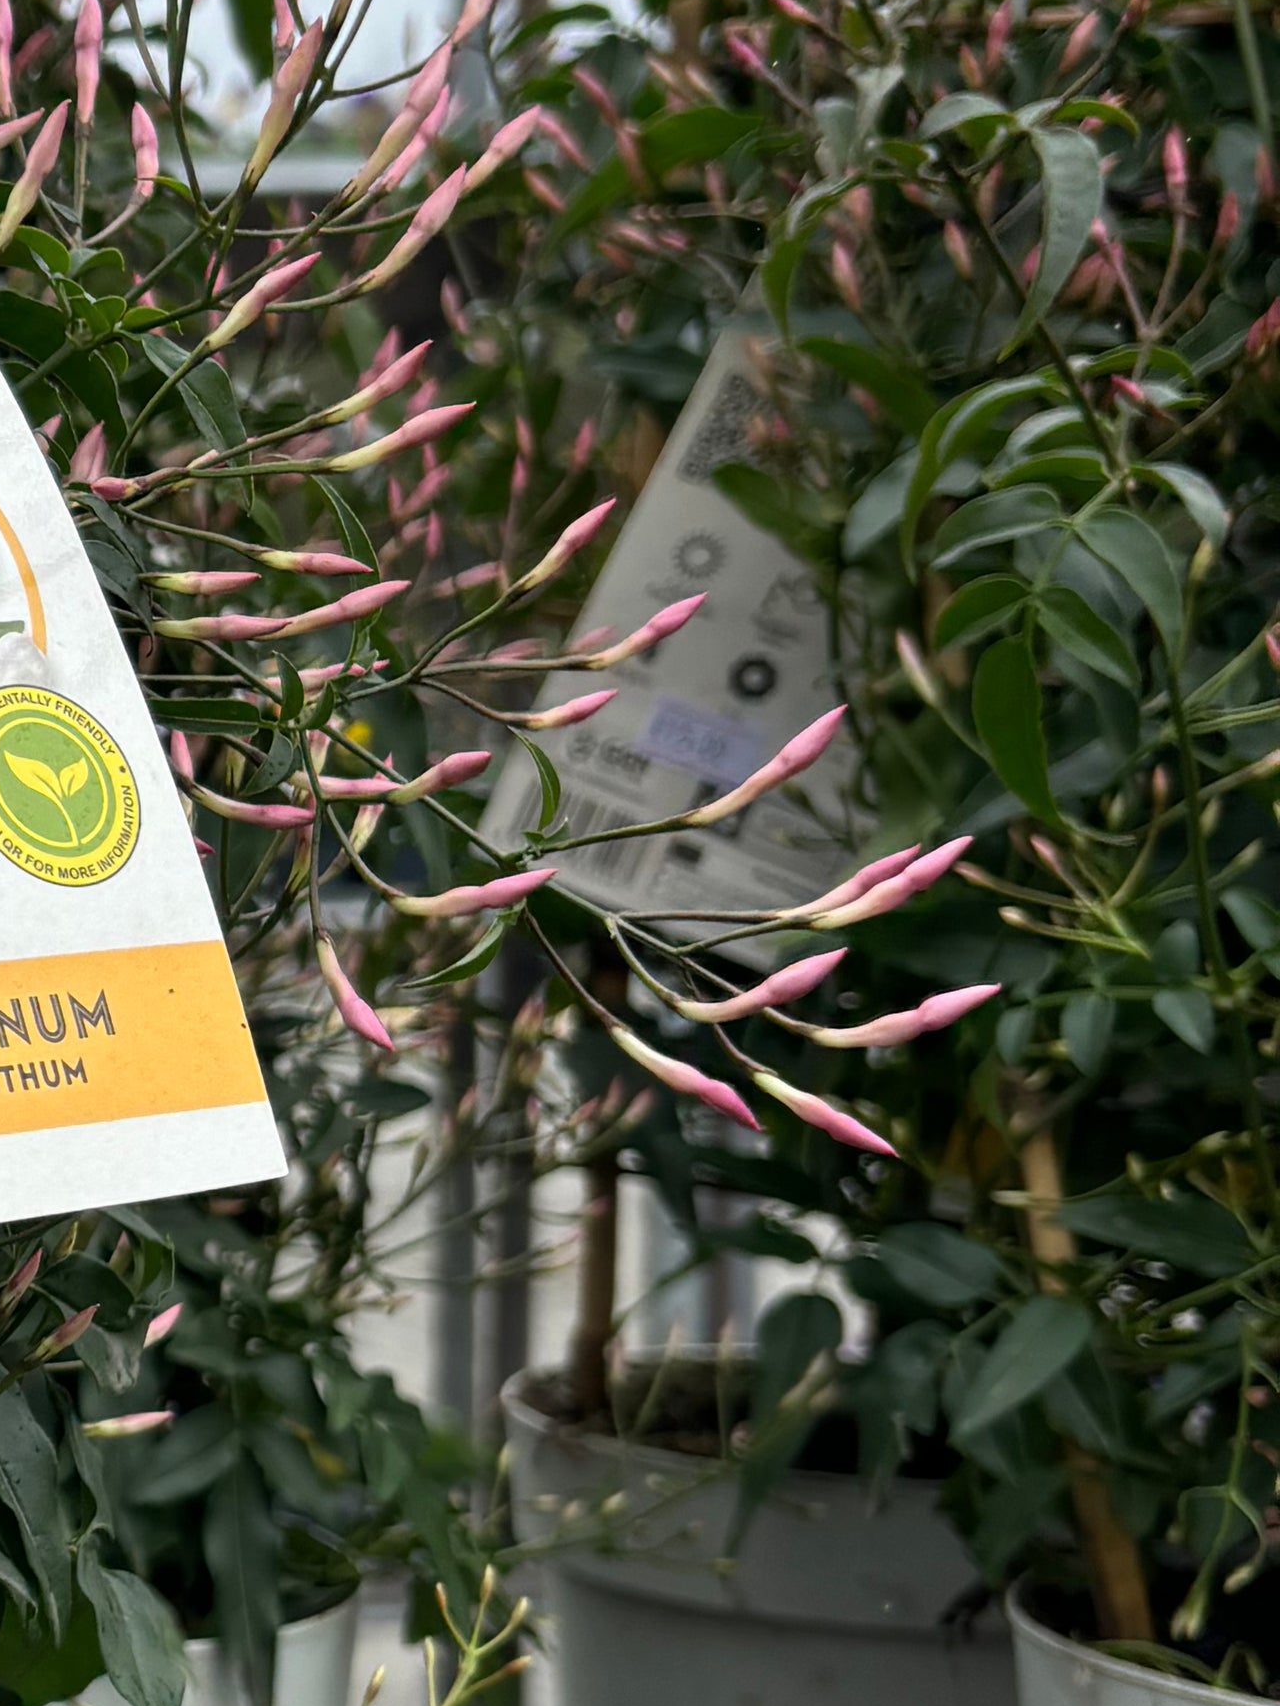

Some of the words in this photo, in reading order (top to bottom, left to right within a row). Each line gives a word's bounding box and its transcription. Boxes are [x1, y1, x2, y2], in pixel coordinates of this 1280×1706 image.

[55, 701, 115, 755] FRIENDLY
[3, 839, 23, 859] QR
[25, 854, 54, 876] FOR
[57, 864, 98, 880] MORE
[98, 785, 134, 873] INFORMATION
